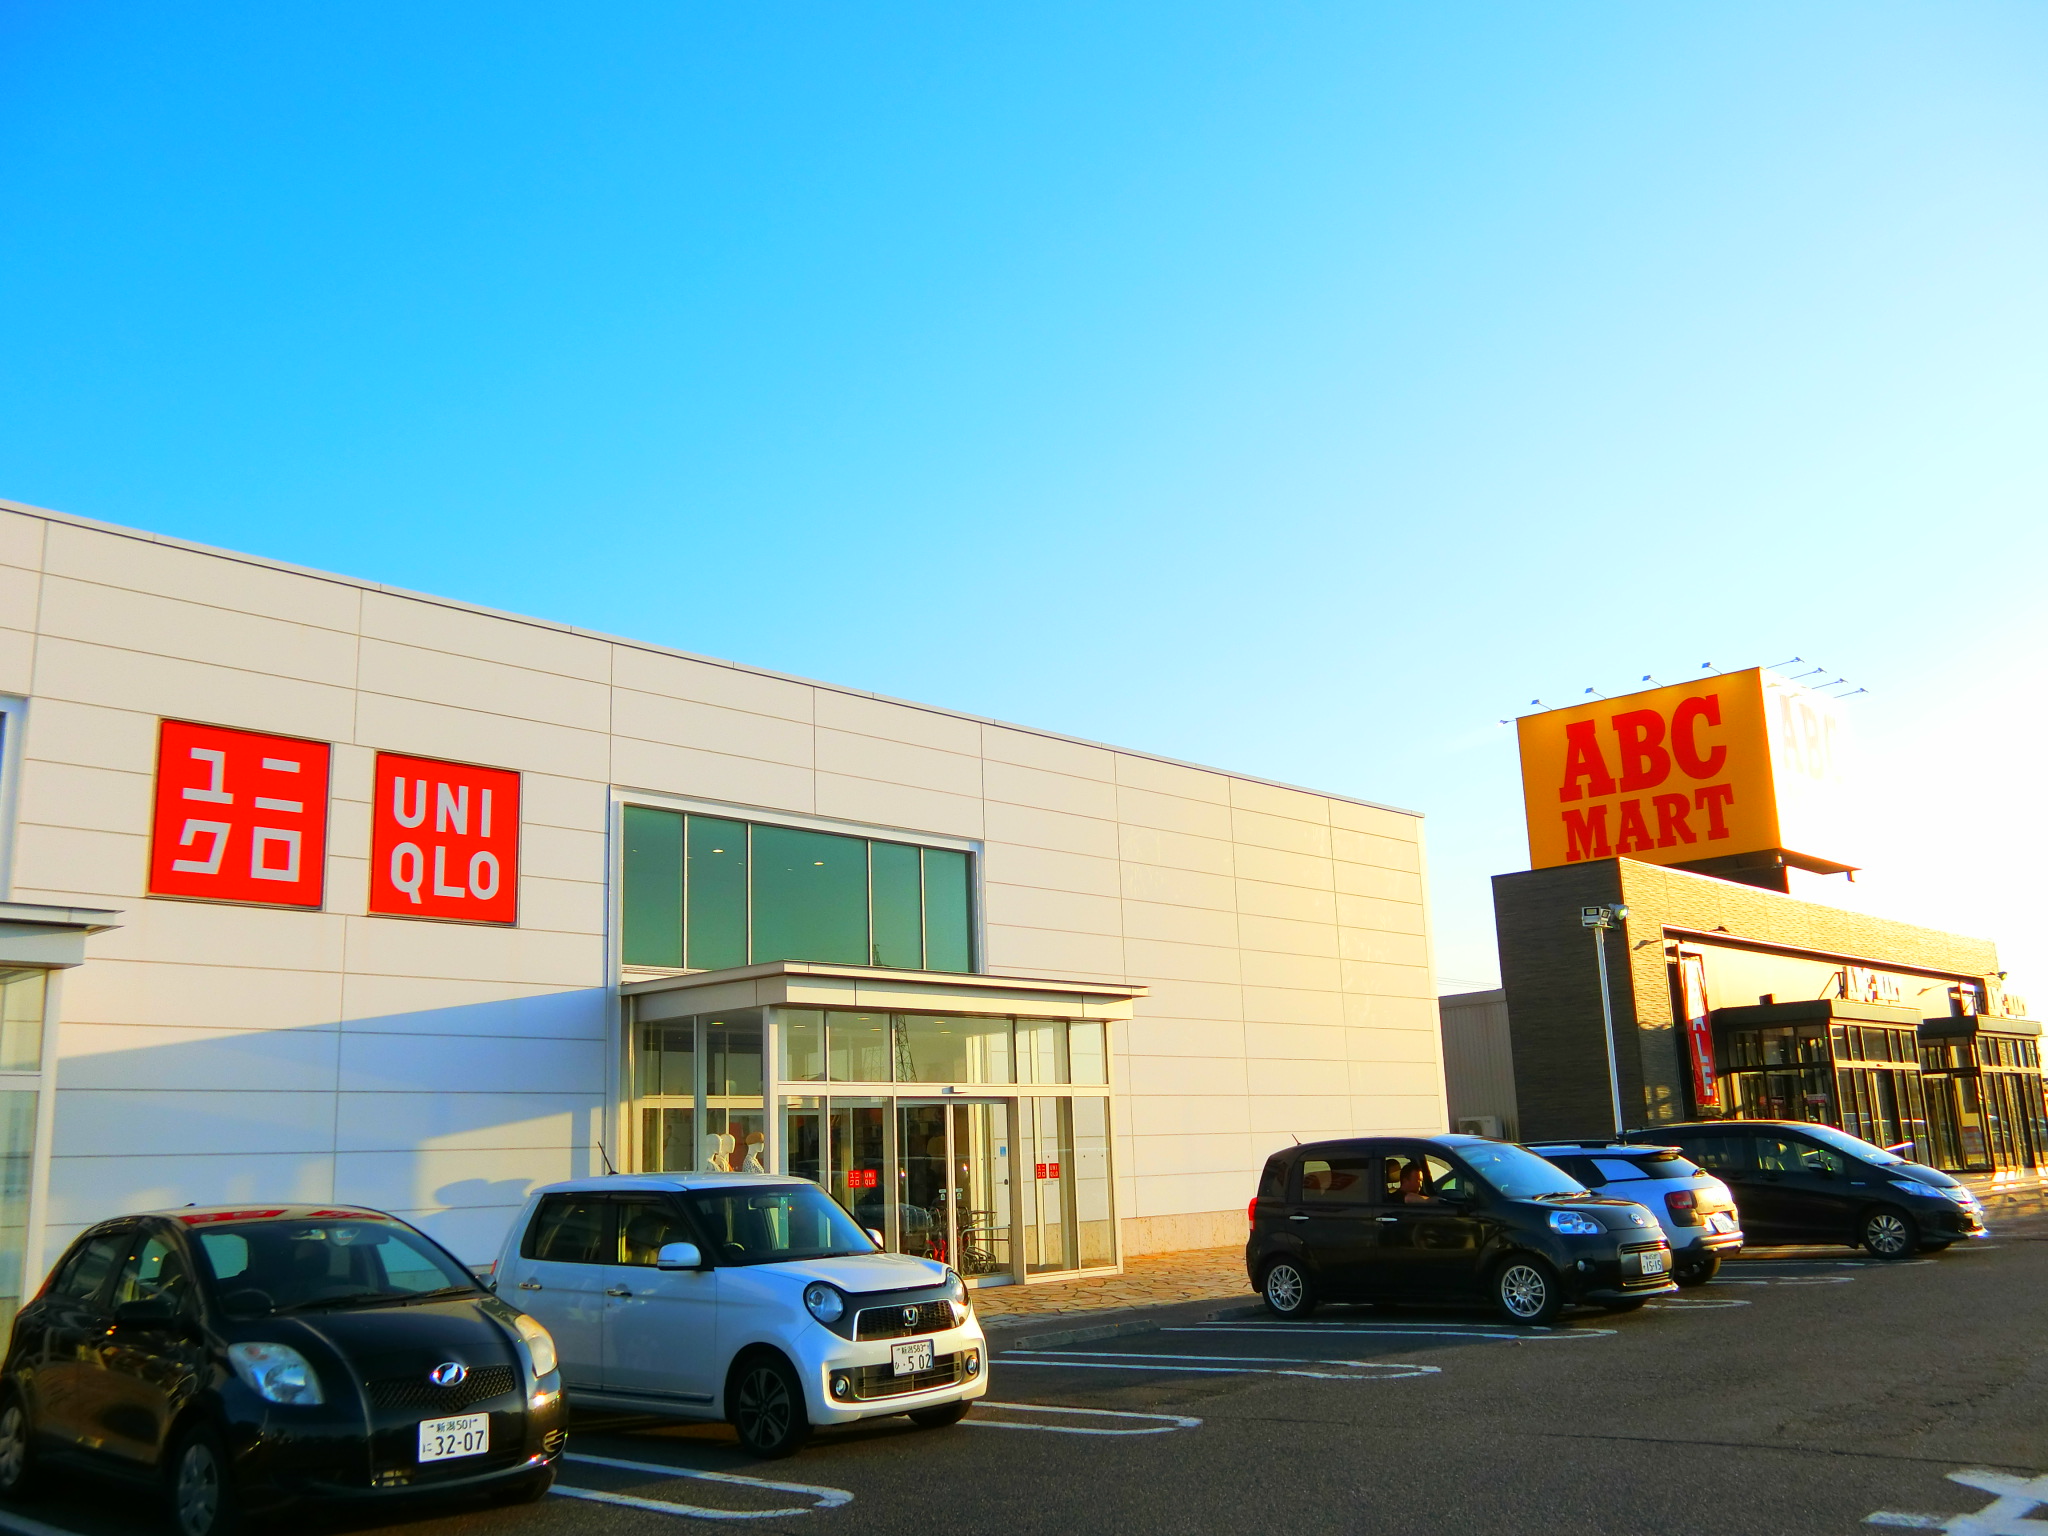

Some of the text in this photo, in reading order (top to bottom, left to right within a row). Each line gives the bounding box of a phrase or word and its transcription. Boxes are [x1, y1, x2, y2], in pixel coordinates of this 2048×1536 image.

[182, 747, 303, 813] ユニ
[1559, 693, 1727, 803] ABC
[393, 776, 492, 837] UNI
[1561, 783, 1734, 862] MART
[172, 818, 301, 882] クロ
[391, 841, 499, 904] QLO
[435, 1429, 485, 1456] 32-07
